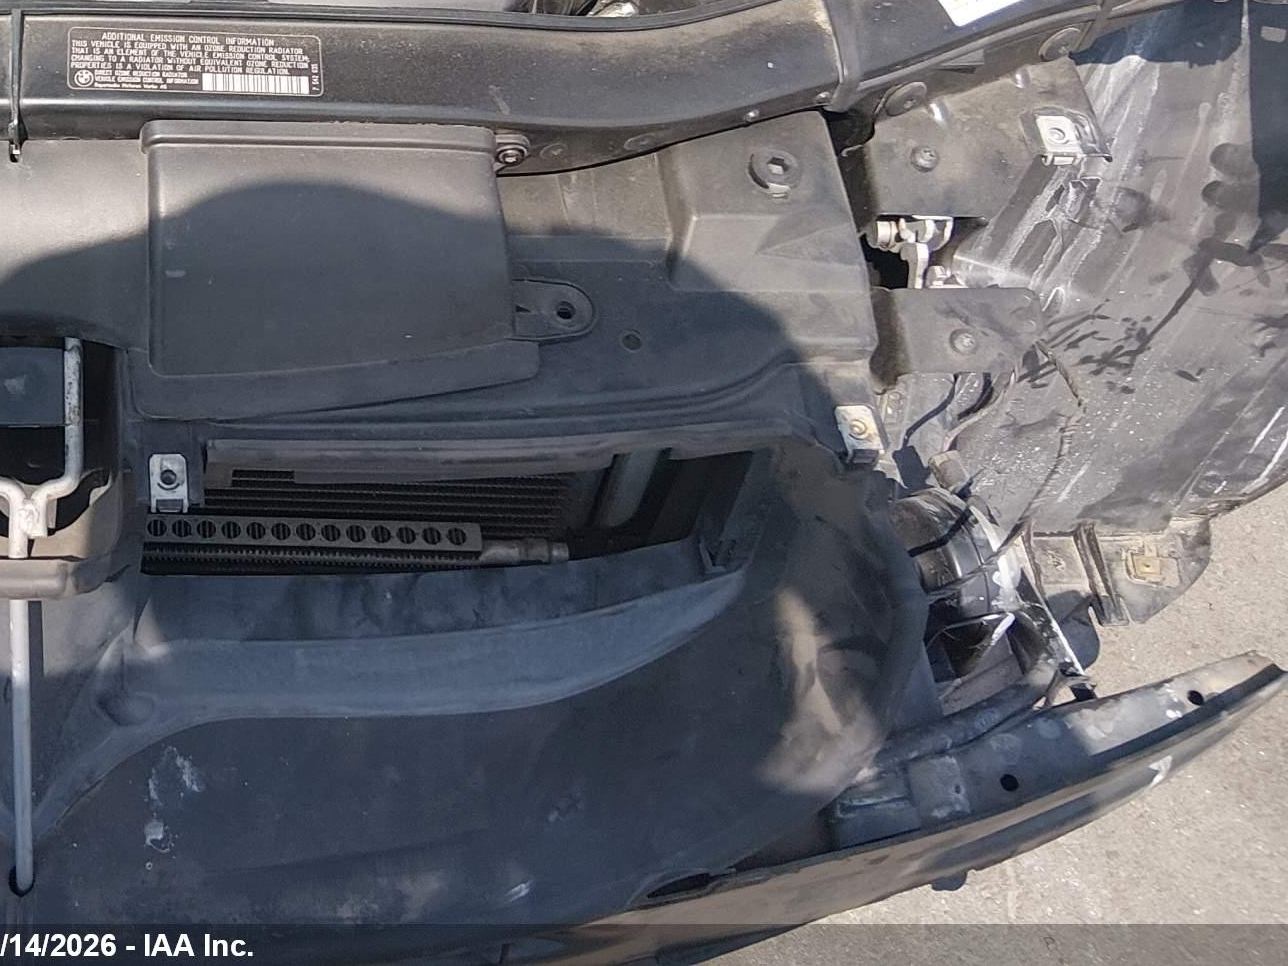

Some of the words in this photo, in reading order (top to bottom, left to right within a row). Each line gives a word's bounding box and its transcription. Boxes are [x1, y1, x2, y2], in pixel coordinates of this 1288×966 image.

[102, 33, 145, 41] ADDITIONAL
[226, 37, 274, 45] INFORMATION
[229, 45, 265, 53] REDUCTION
